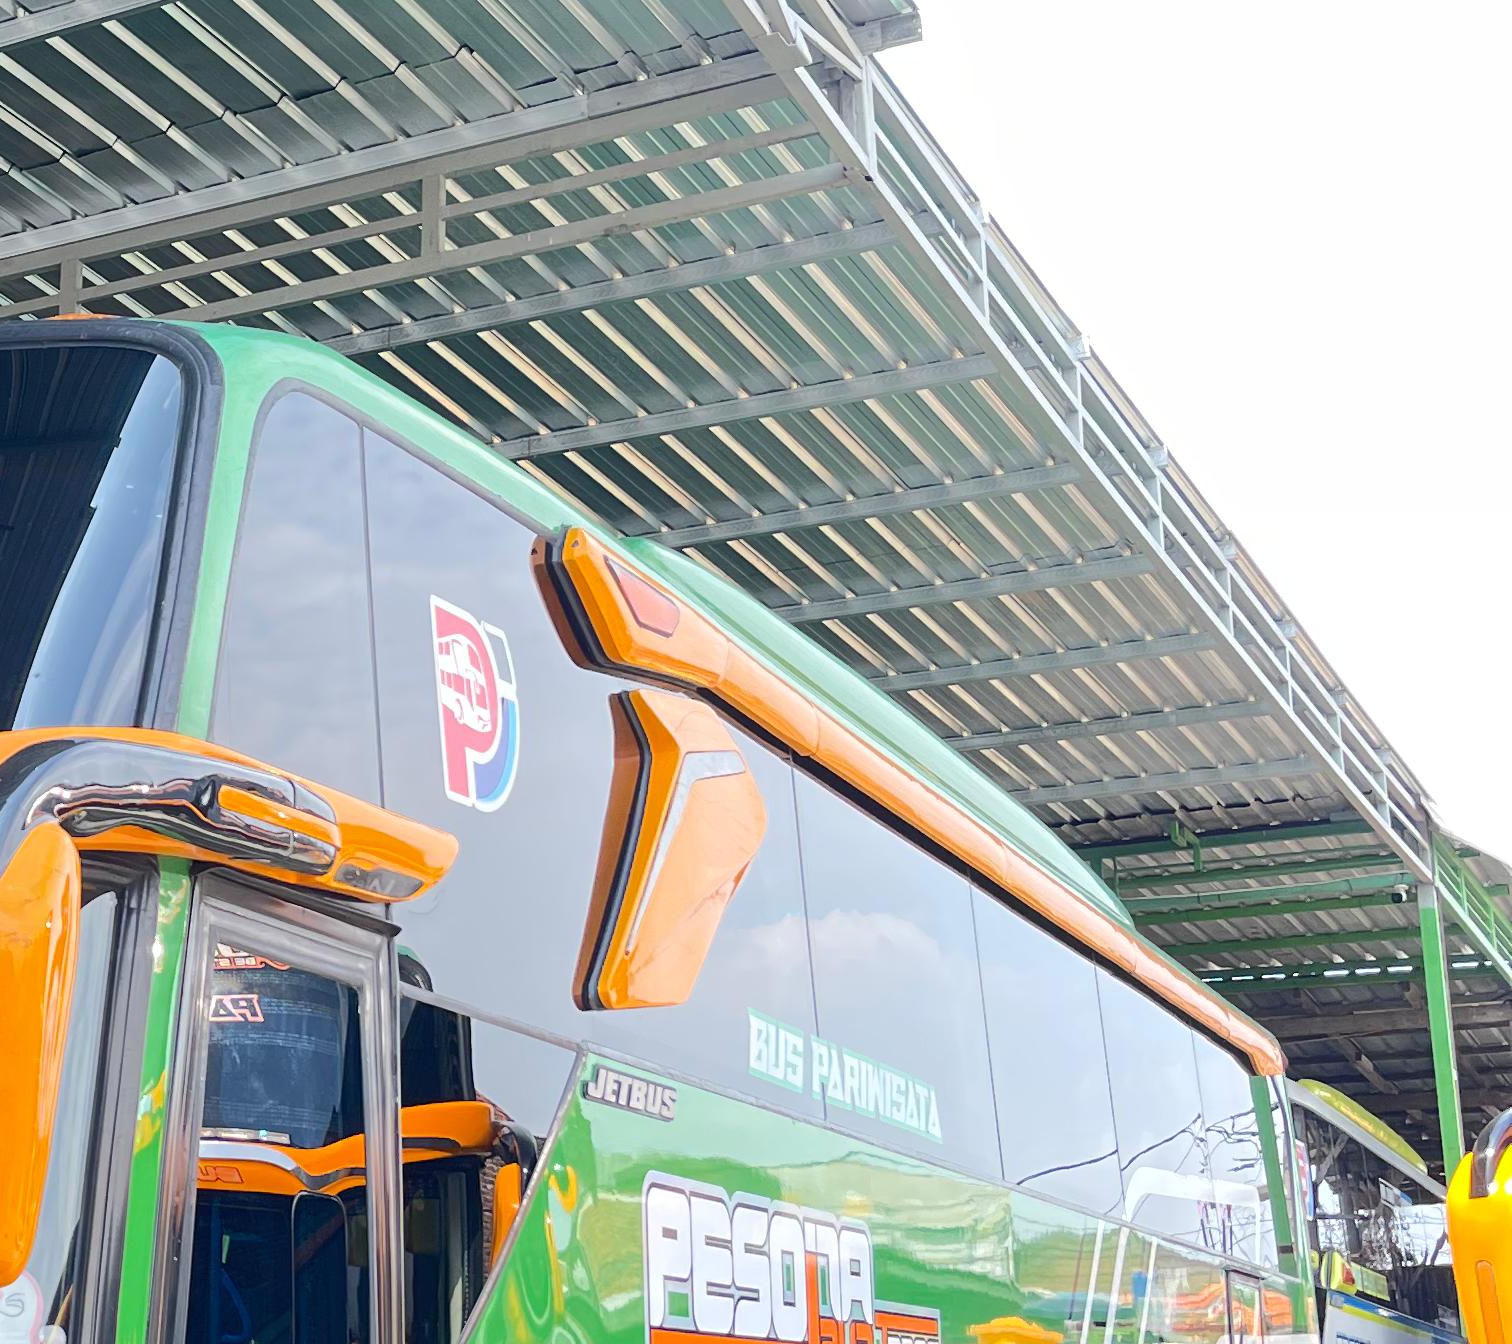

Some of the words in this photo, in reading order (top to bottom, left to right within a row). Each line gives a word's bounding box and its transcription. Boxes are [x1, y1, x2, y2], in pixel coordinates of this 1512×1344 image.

[586, 1067, 678, 1120] JETBUS
[748, 1009, 804, 1091] BUS
[810, 1036, 943, 1142] PARIWISATA
